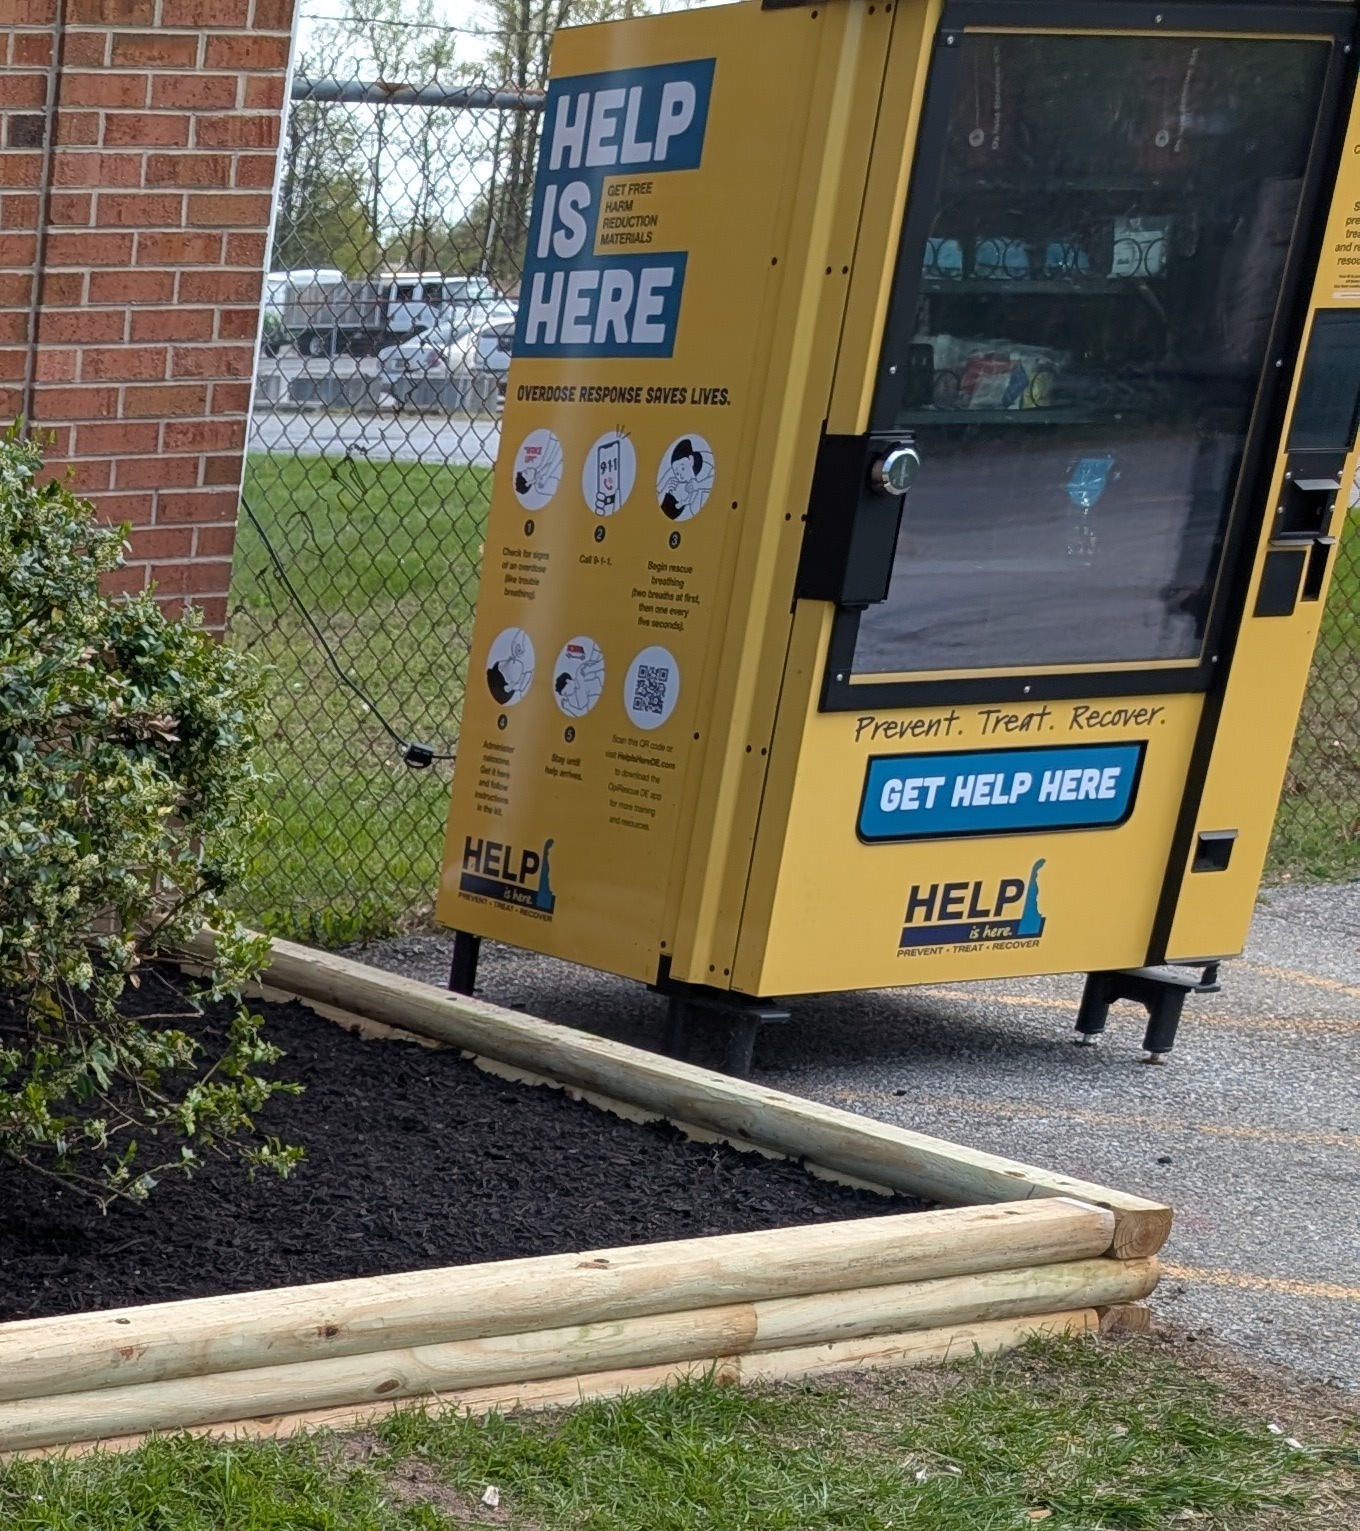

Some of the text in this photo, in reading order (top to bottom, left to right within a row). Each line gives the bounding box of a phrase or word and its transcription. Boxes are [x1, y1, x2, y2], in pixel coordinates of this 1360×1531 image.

[549, 81, 696, 170] HELP
[608, 182, 653, 197] GET FREE
[605, 200, 633, 213] HARM
[536, 180, 591, 259] IS
[603, 215, 658, 229] REDUCTION
[600, 231, 654, 245] MATERIALS
[1335, 242, 1353, 252] and
[525, 267, 674, 344] HERE
[517, 385, 732, 406] OVERDOSE RESPONSE SAVES LIVES.
[502, 547, 521, 558] Check
[523, 549, 532, 558] for
[579, 554, 592, 564] Call
[647, 561, 693, 574] Begin rescue
[651, 576, 685, 590] breathing
[648, 590, 675, 601] breaths
[676, 593, 683, 602] at
[639, 603, 689, 619] then one every
[638, 616, 650, 627] five
[854, 704, 1166, 743] Prevent. Treat. Recover.
[612, 734, 626, 744] Scan
[639, 739, 650, 748] QR
[650, 743, 665, 751] code
[551, 752, 565, 766] Stay
[545, 765, 558, 778] help
[880, 767, 1121, 812] GET HELP HERE
[462, 836, 540, 884] HELP
[504, 886, 511, 899] is
[458, 891, 553, 922] PREVENT TREAT RECOVER
[904, 878, 1025, 924] HELP
[969, 926, 979, 939] is
[897, 939, 1040, 958] PREVENT TREAT RECOVER
